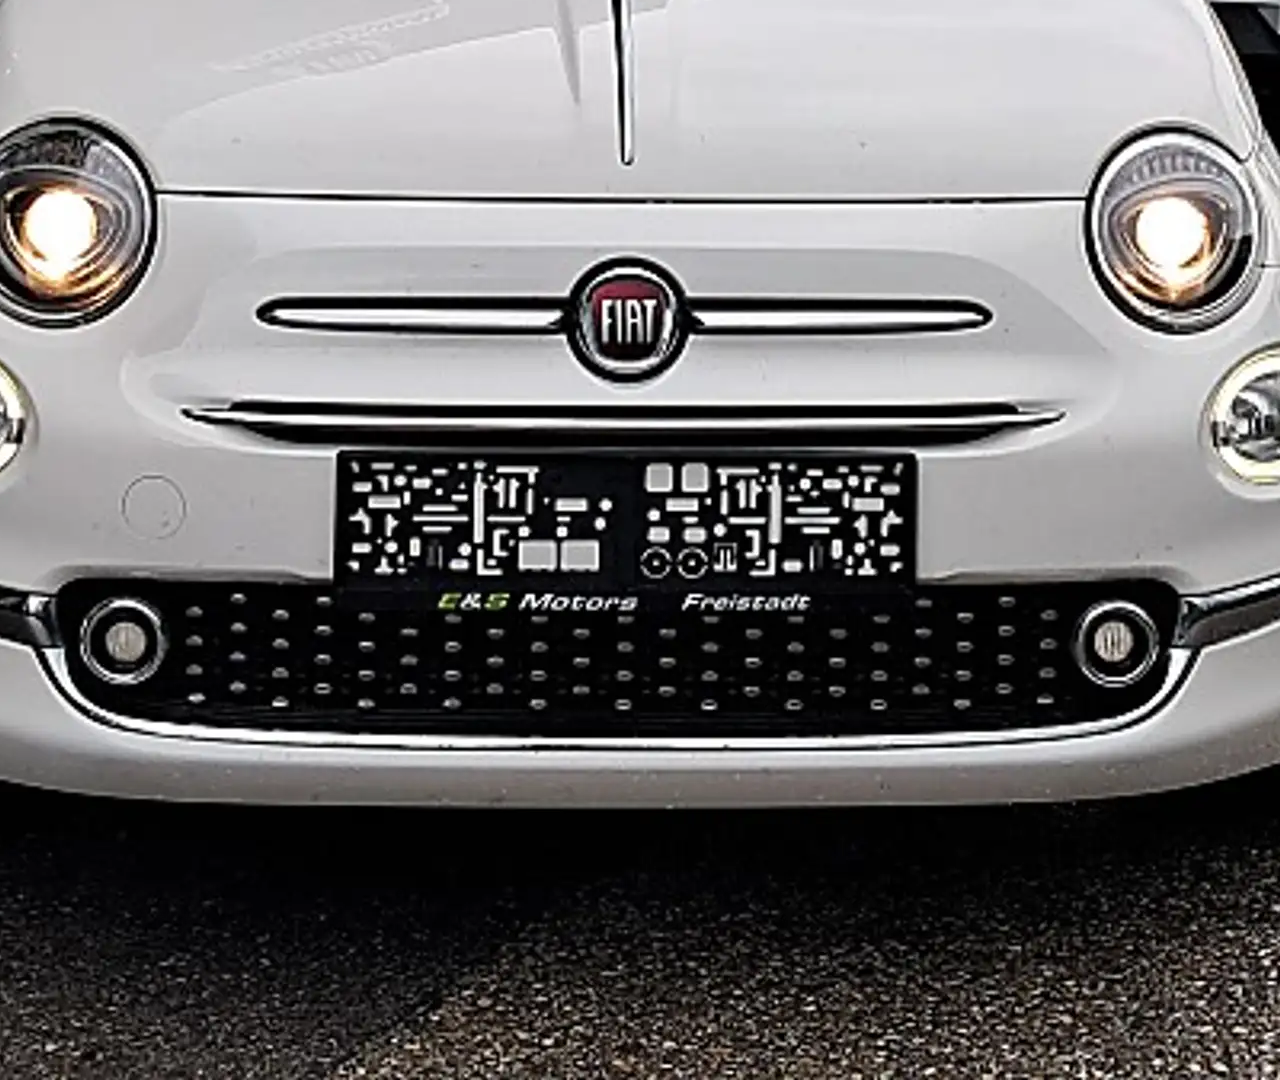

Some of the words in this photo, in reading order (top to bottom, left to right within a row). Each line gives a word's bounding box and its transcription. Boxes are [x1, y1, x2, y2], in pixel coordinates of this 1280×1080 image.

[600, 298, 658, 346] FIAT
[437, 592, 510, 612] E&S
[518, 592, 639, 612] Motors
[681, 593, 812, 611] Freistadt
